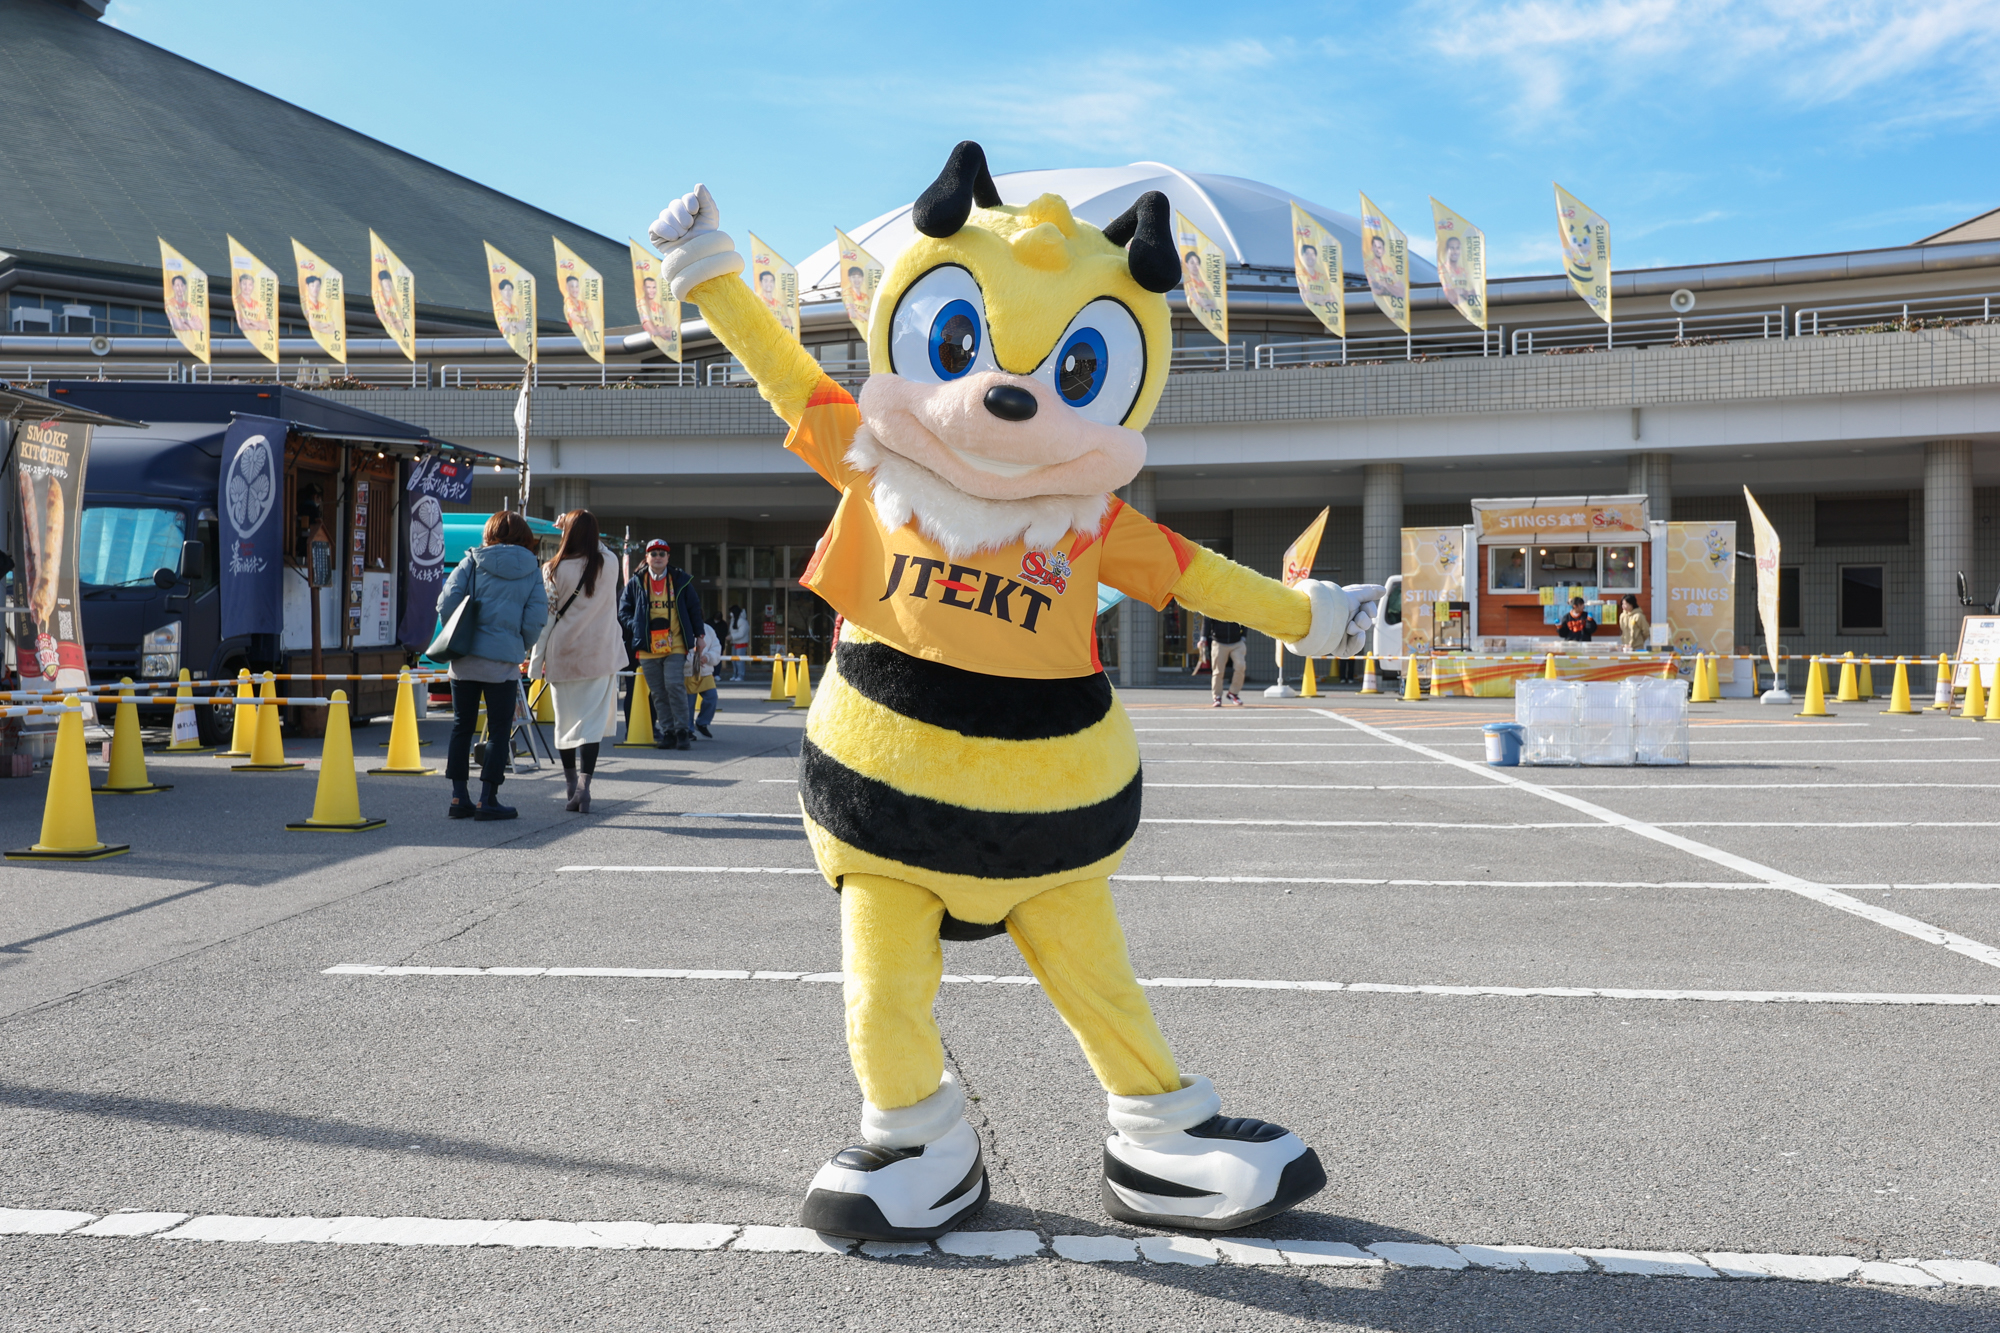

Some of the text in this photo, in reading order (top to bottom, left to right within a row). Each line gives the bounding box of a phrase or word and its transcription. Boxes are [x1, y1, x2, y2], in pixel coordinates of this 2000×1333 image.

[27, 424, 68, 448] SMOKE
[20, 442, 70, 467] KITCHEN
[1499, 512, 1586, 528] STINGS食堂
[879, 553, 1052, 634] JTEKT
[1406, 590, 1457, 602] STINGS
[1671, 587, 1730, 601] STINGS
[650, 600, 676, 609] TEKT
[1419, 603, 1434, 617] 食
[1686, 602, 1714, 617] 食堂
